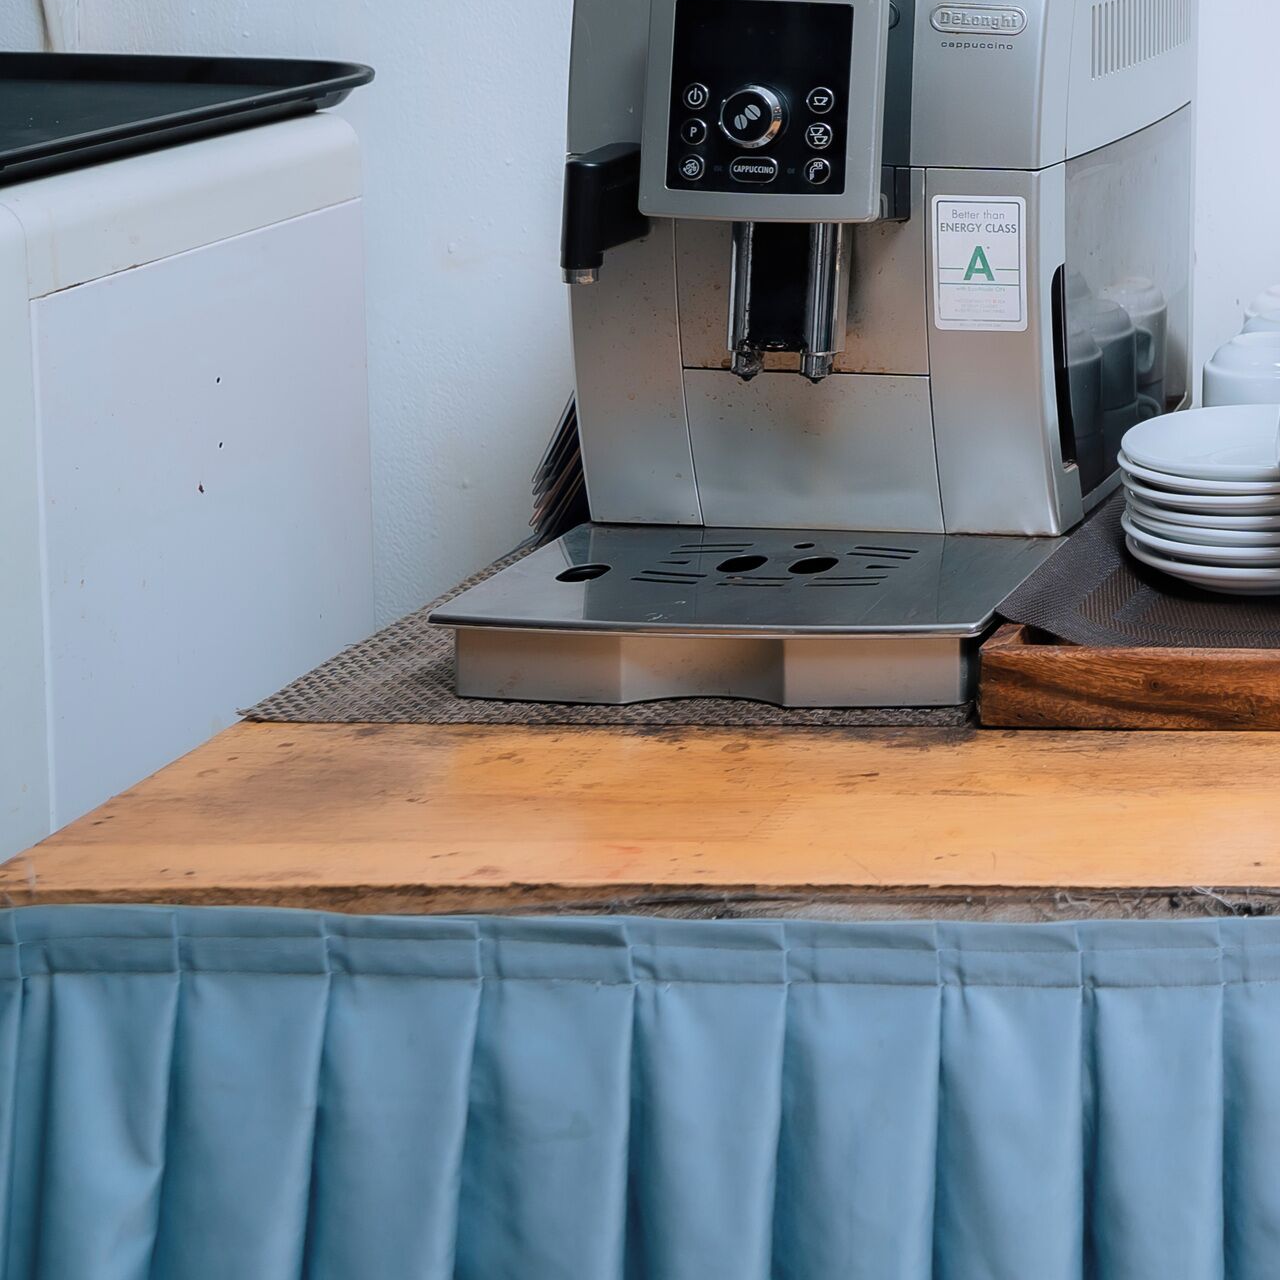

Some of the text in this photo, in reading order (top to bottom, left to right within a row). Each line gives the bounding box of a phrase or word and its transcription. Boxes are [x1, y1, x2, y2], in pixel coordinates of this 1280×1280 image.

[940, 41, 1014, 51] cappuccino
[689, 126, 698, 138] P
[733, 164, 775, 175] CAPPUCCINO
[951, 209, 1005, 220] Better than
[940, 222, 1017, 234] ENERGY CLASS
